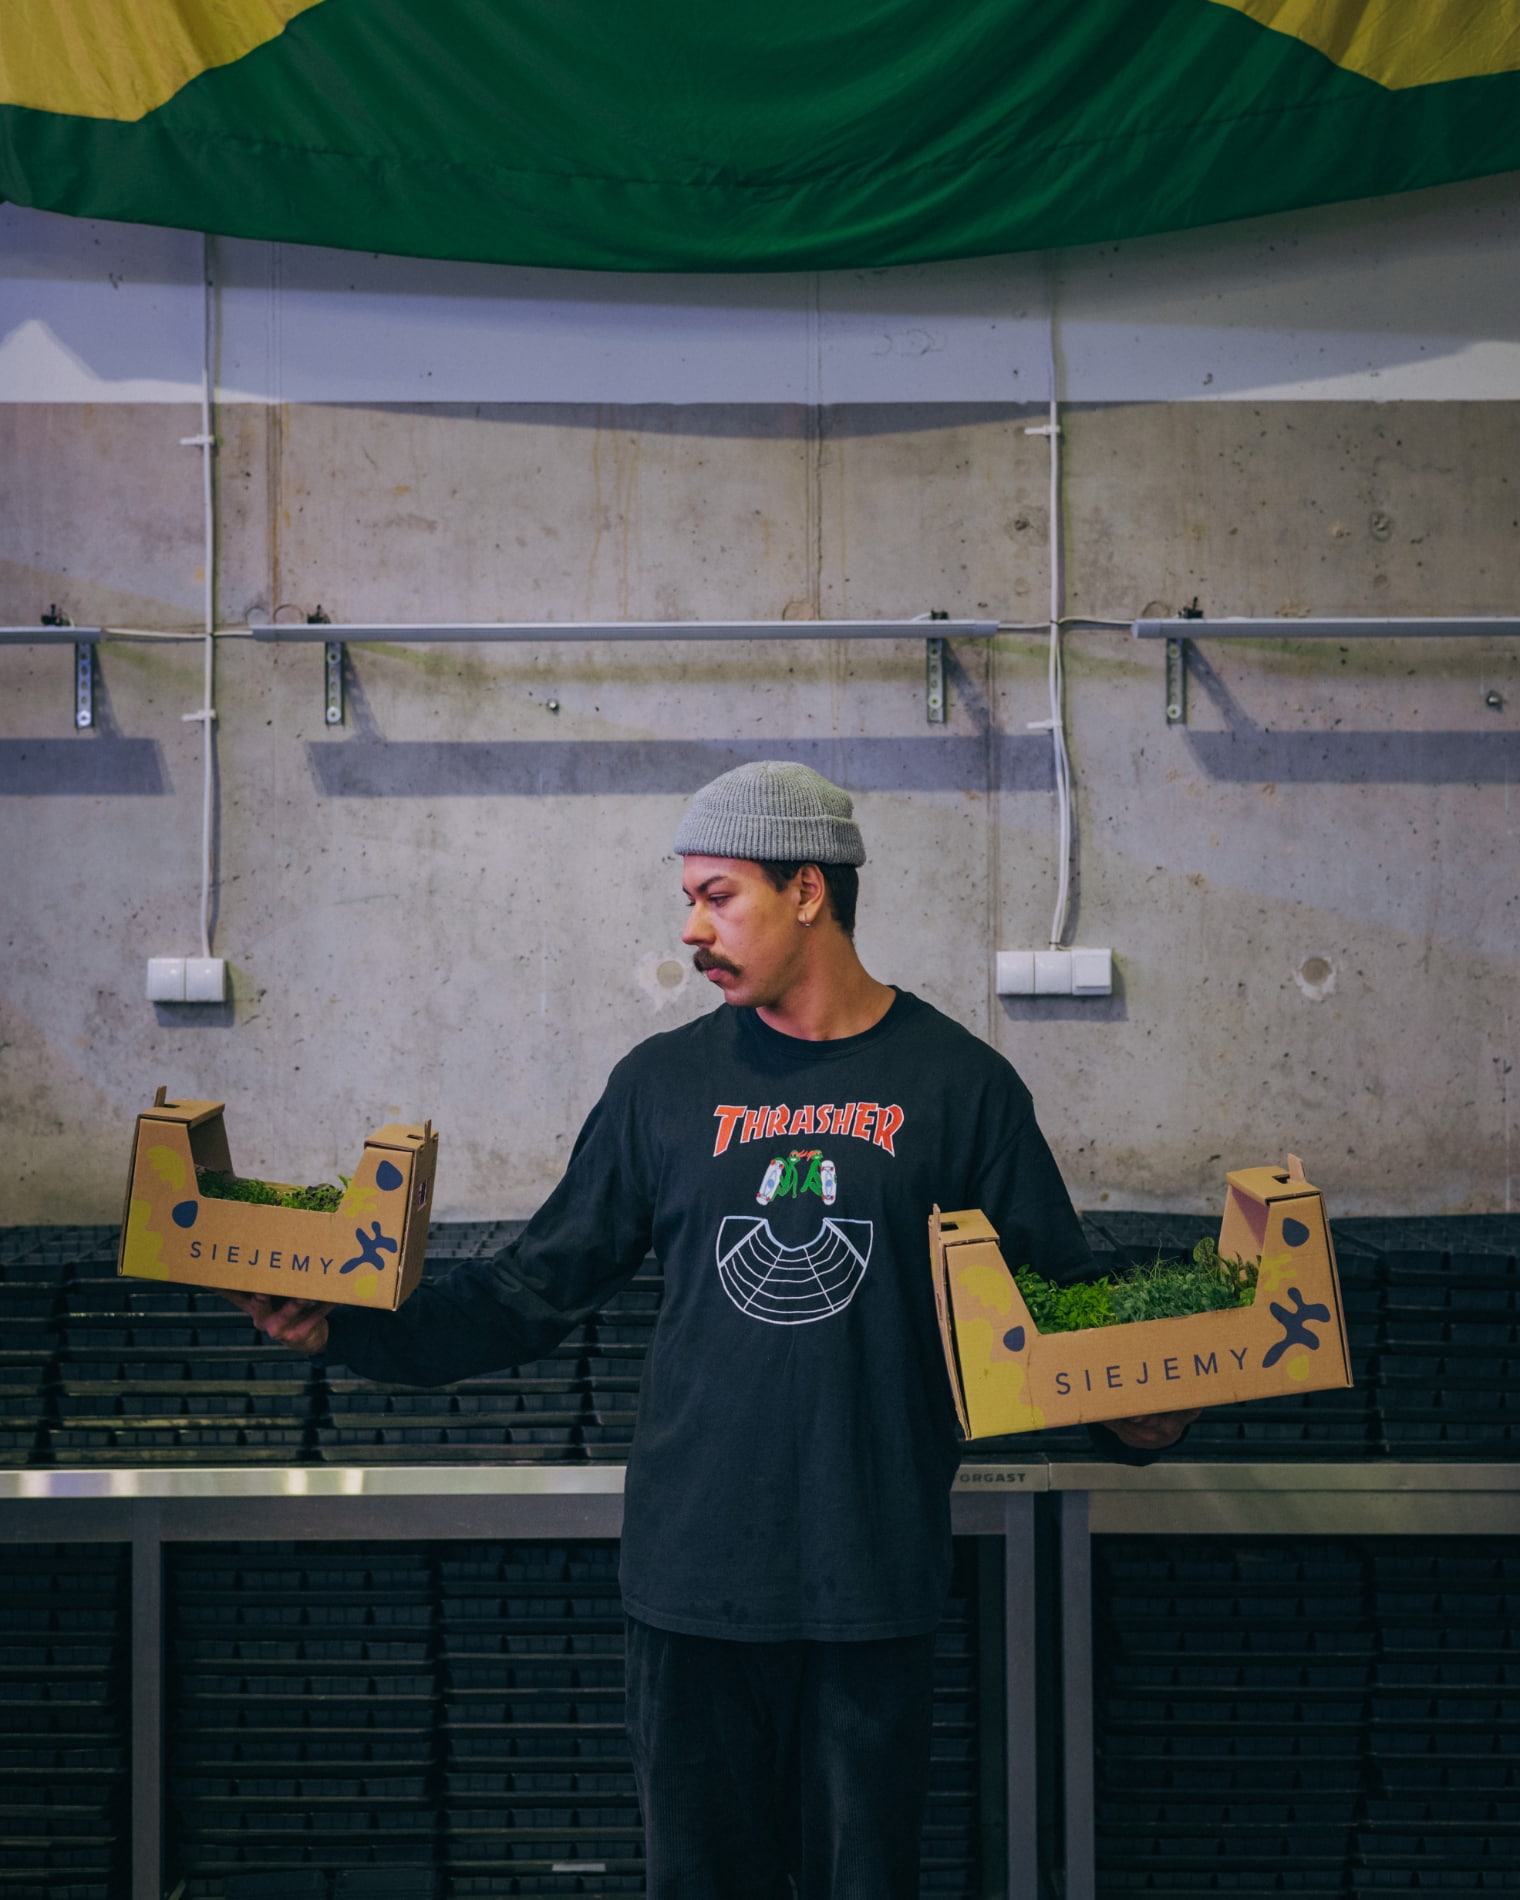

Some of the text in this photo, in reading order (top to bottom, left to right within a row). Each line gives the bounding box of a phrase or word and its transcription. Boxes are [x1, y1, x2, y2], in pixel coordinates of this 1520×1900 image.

[713, 1102, 904, 1158] THRASHER
[190, 1240, 334, 1275] SIEJEMY
[1055, 1346, 1248, 1396] SIEJEMY
[955, 1472, 1026, 1483] ORGAST
